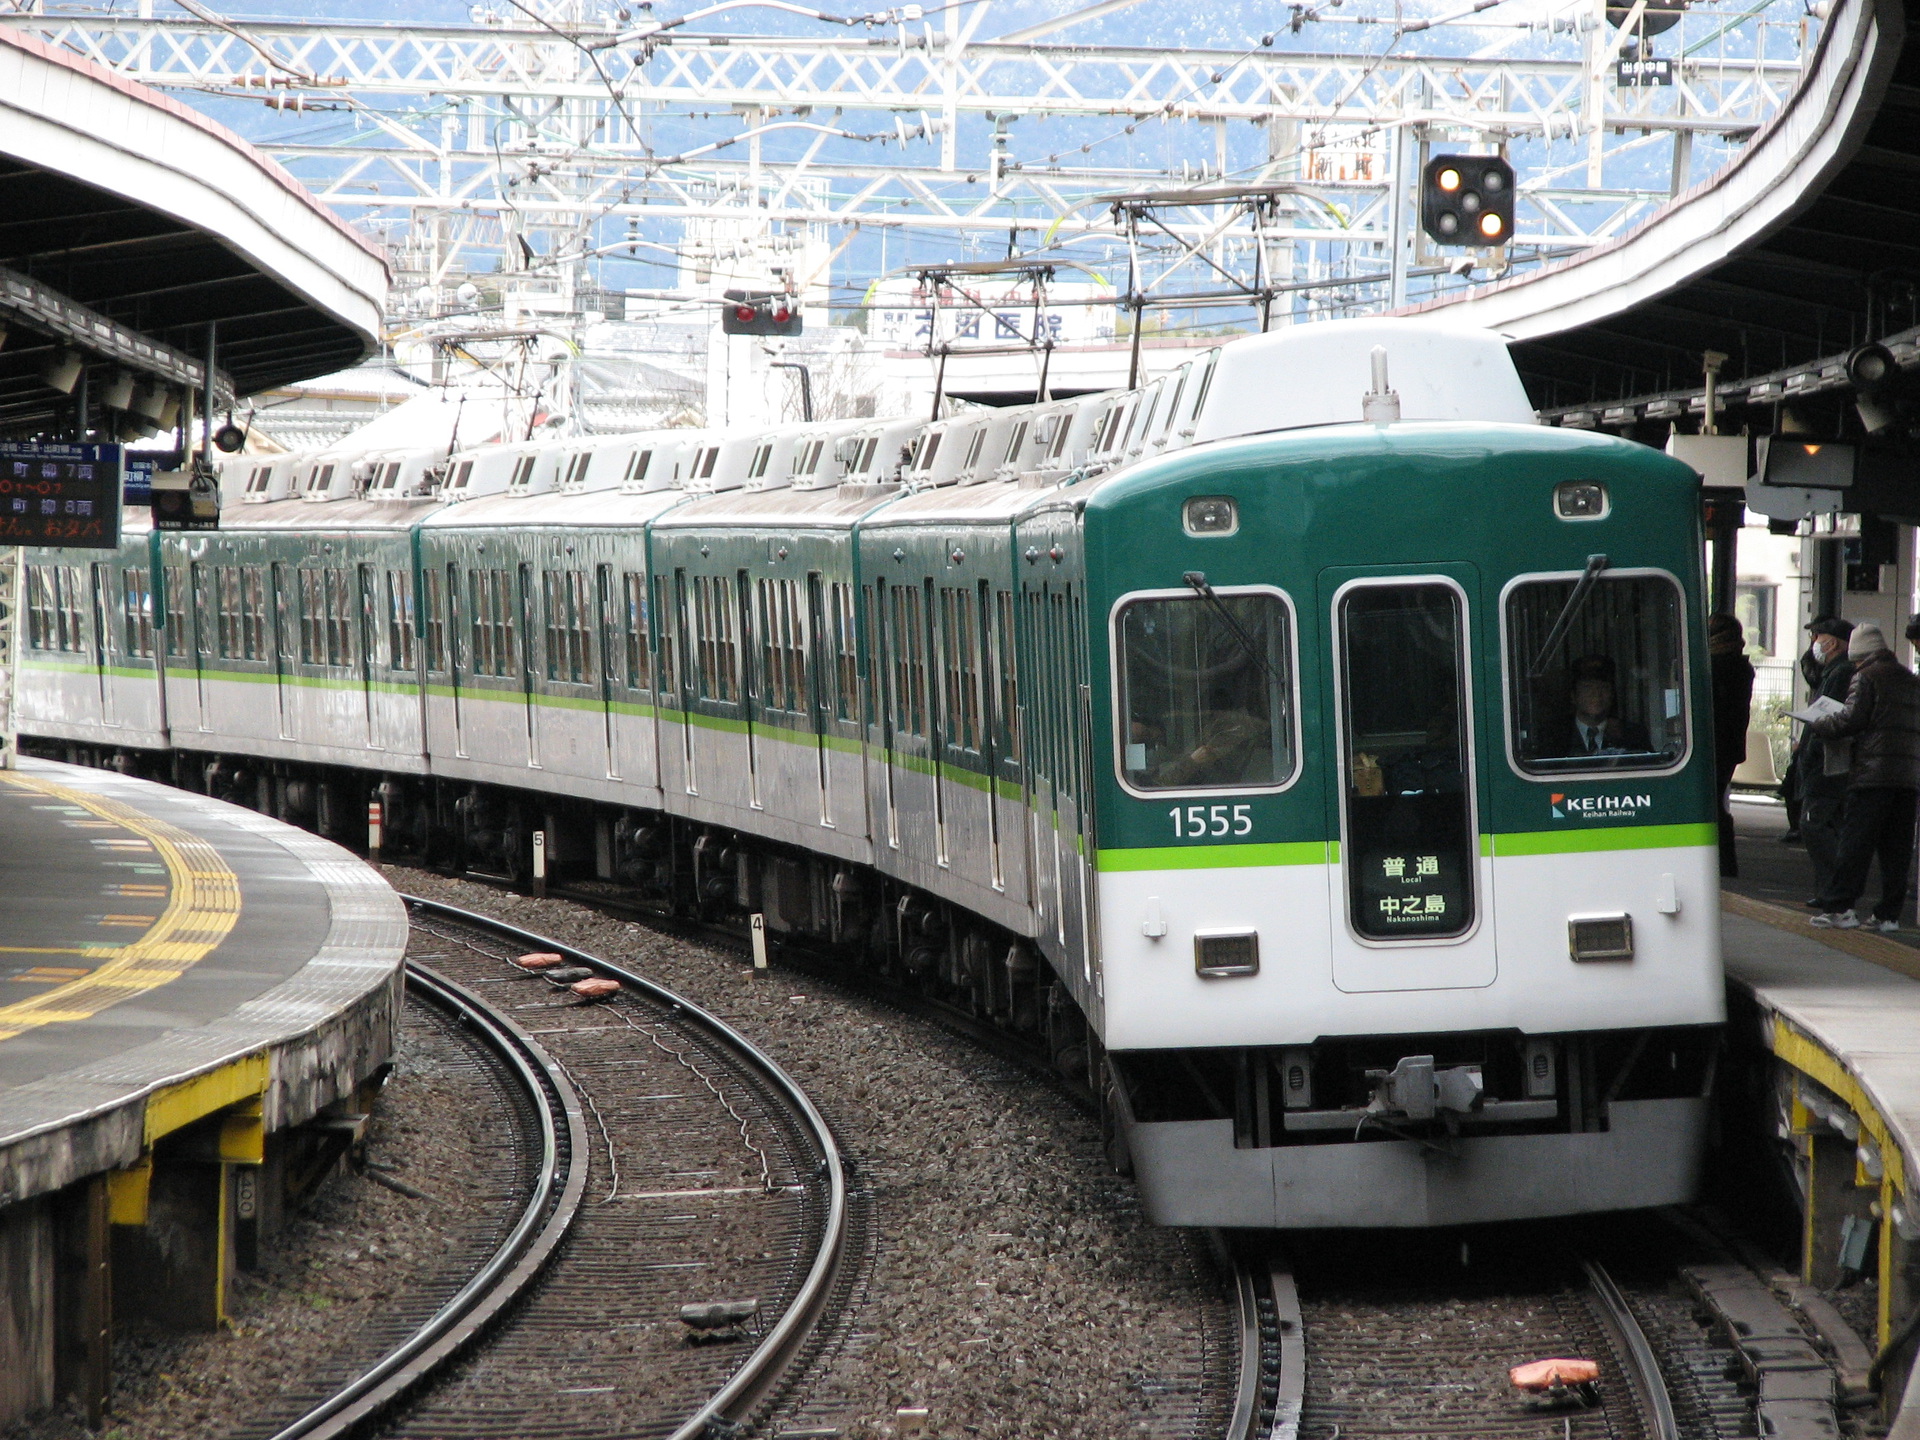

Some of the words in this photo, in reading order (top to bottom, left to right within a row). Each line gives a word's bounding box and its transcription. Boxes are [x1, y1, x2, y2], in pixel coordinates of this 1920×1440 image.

[92, 445, 100, 461] 1
[1567, 794, 1651, 811] KEIHAN
[1168, 804, 1253, 837] 1555
[1608, 809, 1636, 817] Railway
[535, 834, 543, 846] 5
[1382, 855, 1440, 877] 普通
[1401, 876, 1422, 884] Local
[1379, 894, 1446, 916] 中之島
[753, 916, 763, 931] 4
[1386, 914, 1440, 924] Nakanoshima
